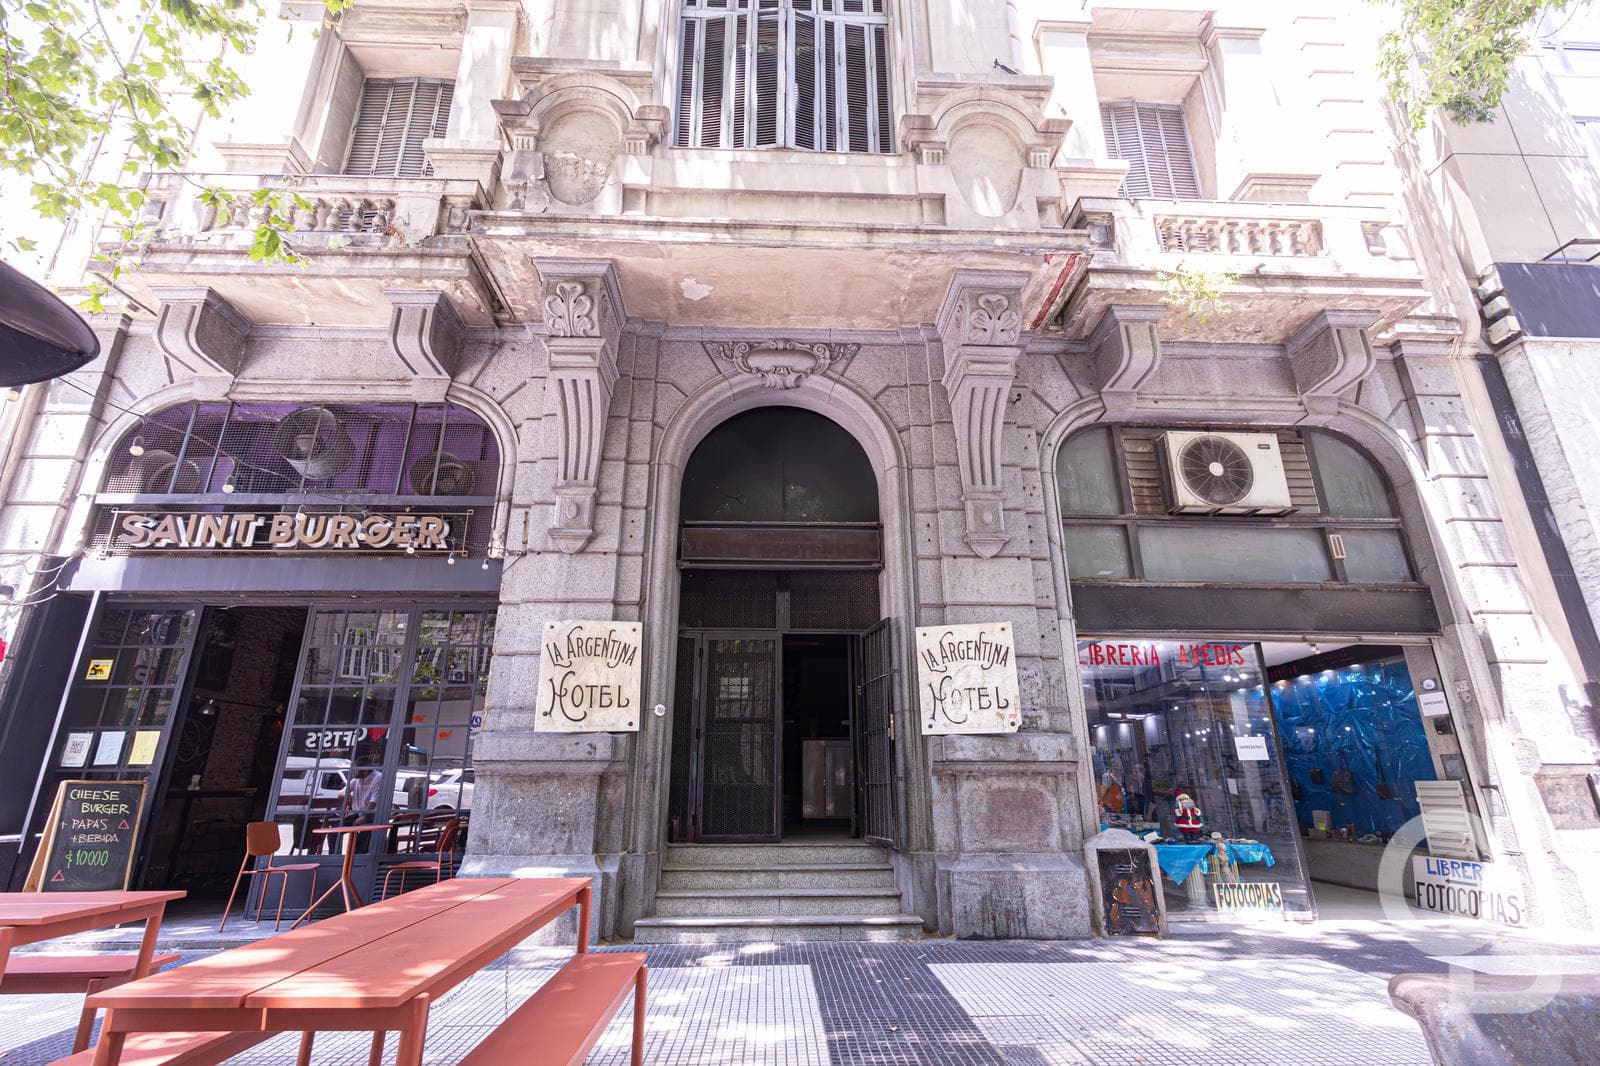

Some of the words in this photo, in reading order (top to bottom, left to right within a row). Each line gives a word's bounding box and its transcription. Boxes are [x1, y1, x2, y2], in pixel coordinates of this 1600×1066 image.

[121, 514, 264, 549] SAINT
[269, 515, 450, 549] BURGER
[546, 642, 572, 668] LA
[567, 626, 637, 668] ARGENTINA
[921, 648, 947, 673] LA
[939, 631, 1009, 670] ARGENTINA
[1180, 644, 1245, 667] AVEDIS
[542, 670, 630, 722] HOTEL
[928, 675, 1009, 724] HOTEL
[70, 789, 120, 801] CHEESE
[81, 802, 130, 815] BURGER
[72, 818, 109, 831] PAPAS
[1426, 858, 1484, 880] LIBRER
[1216, 883, 1282, 909] FOTOCOPIAS
[1416, 881, 1521, 924] FOTOCOPIAS
